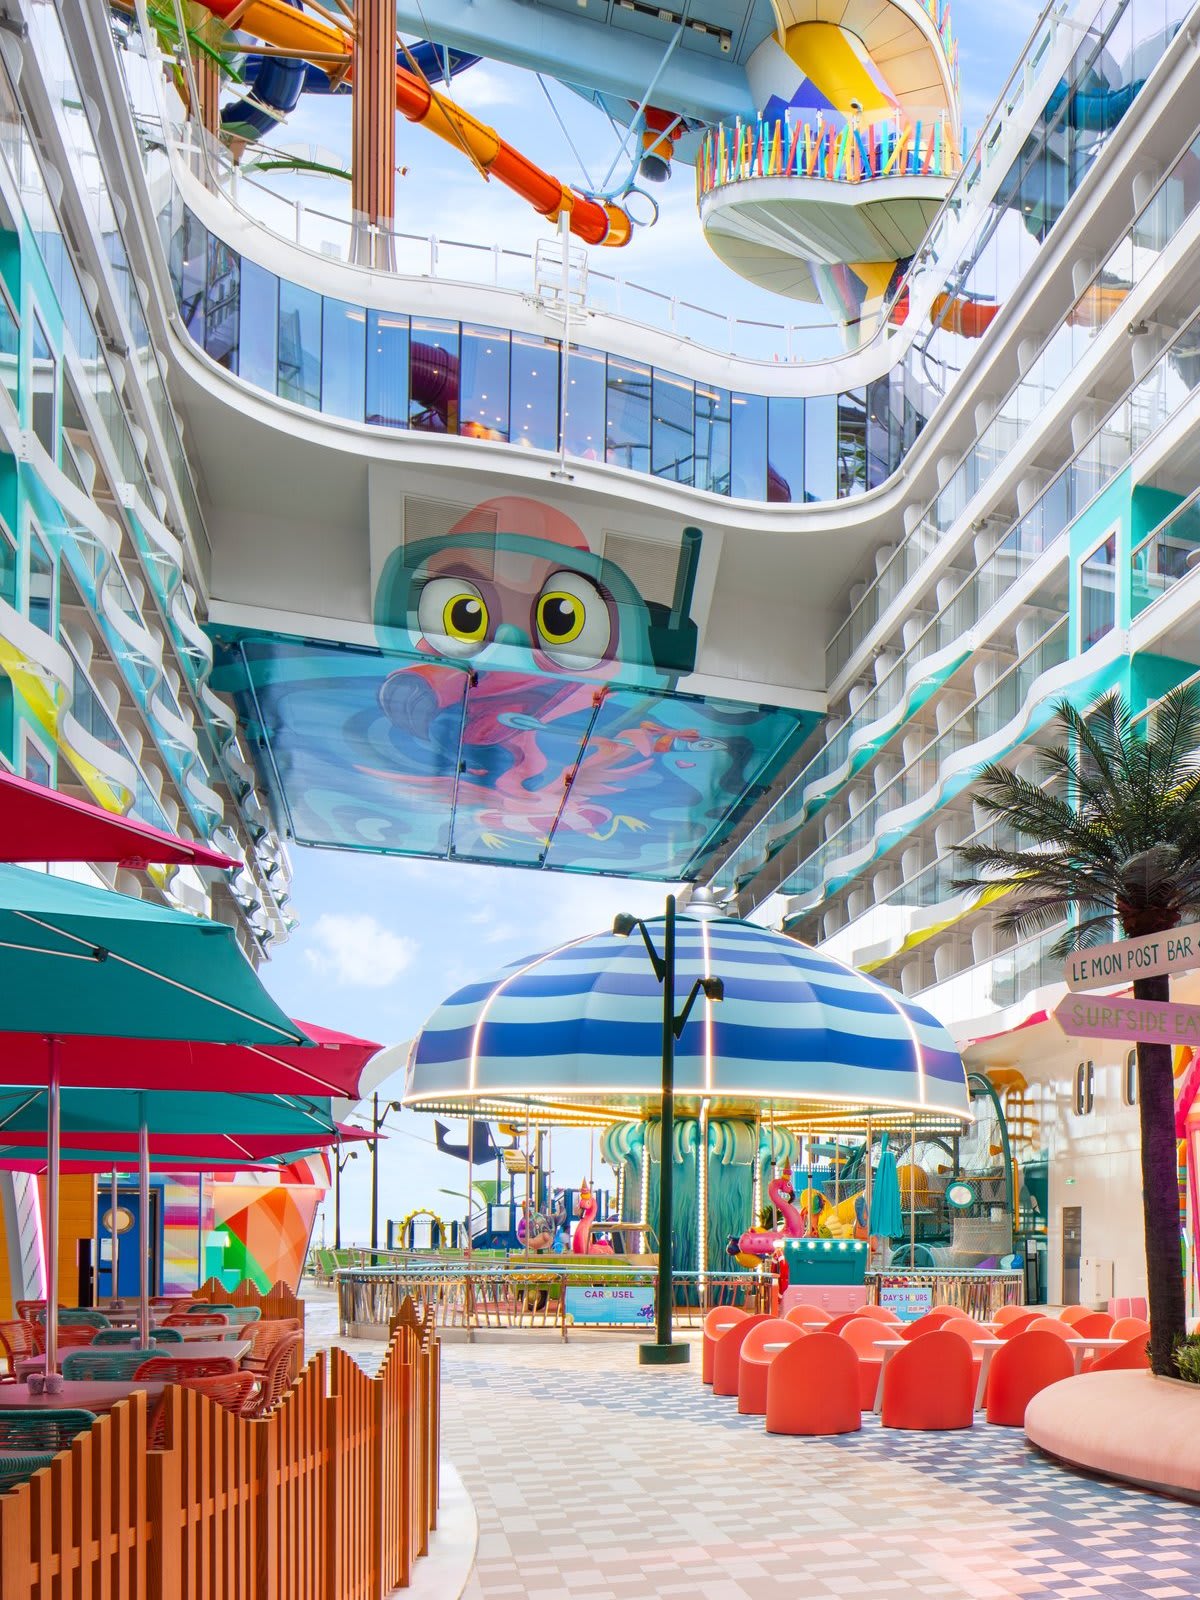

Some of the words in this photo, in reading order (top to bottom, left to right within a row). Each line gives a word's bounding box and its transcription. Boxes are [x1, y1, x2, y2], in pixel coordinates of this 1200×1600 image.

[1127, 943, 1160, 971] POST
[1167, 936, 1194, 962] BAR
[1071, 1003, 1169, 1034] SURFSIDE
